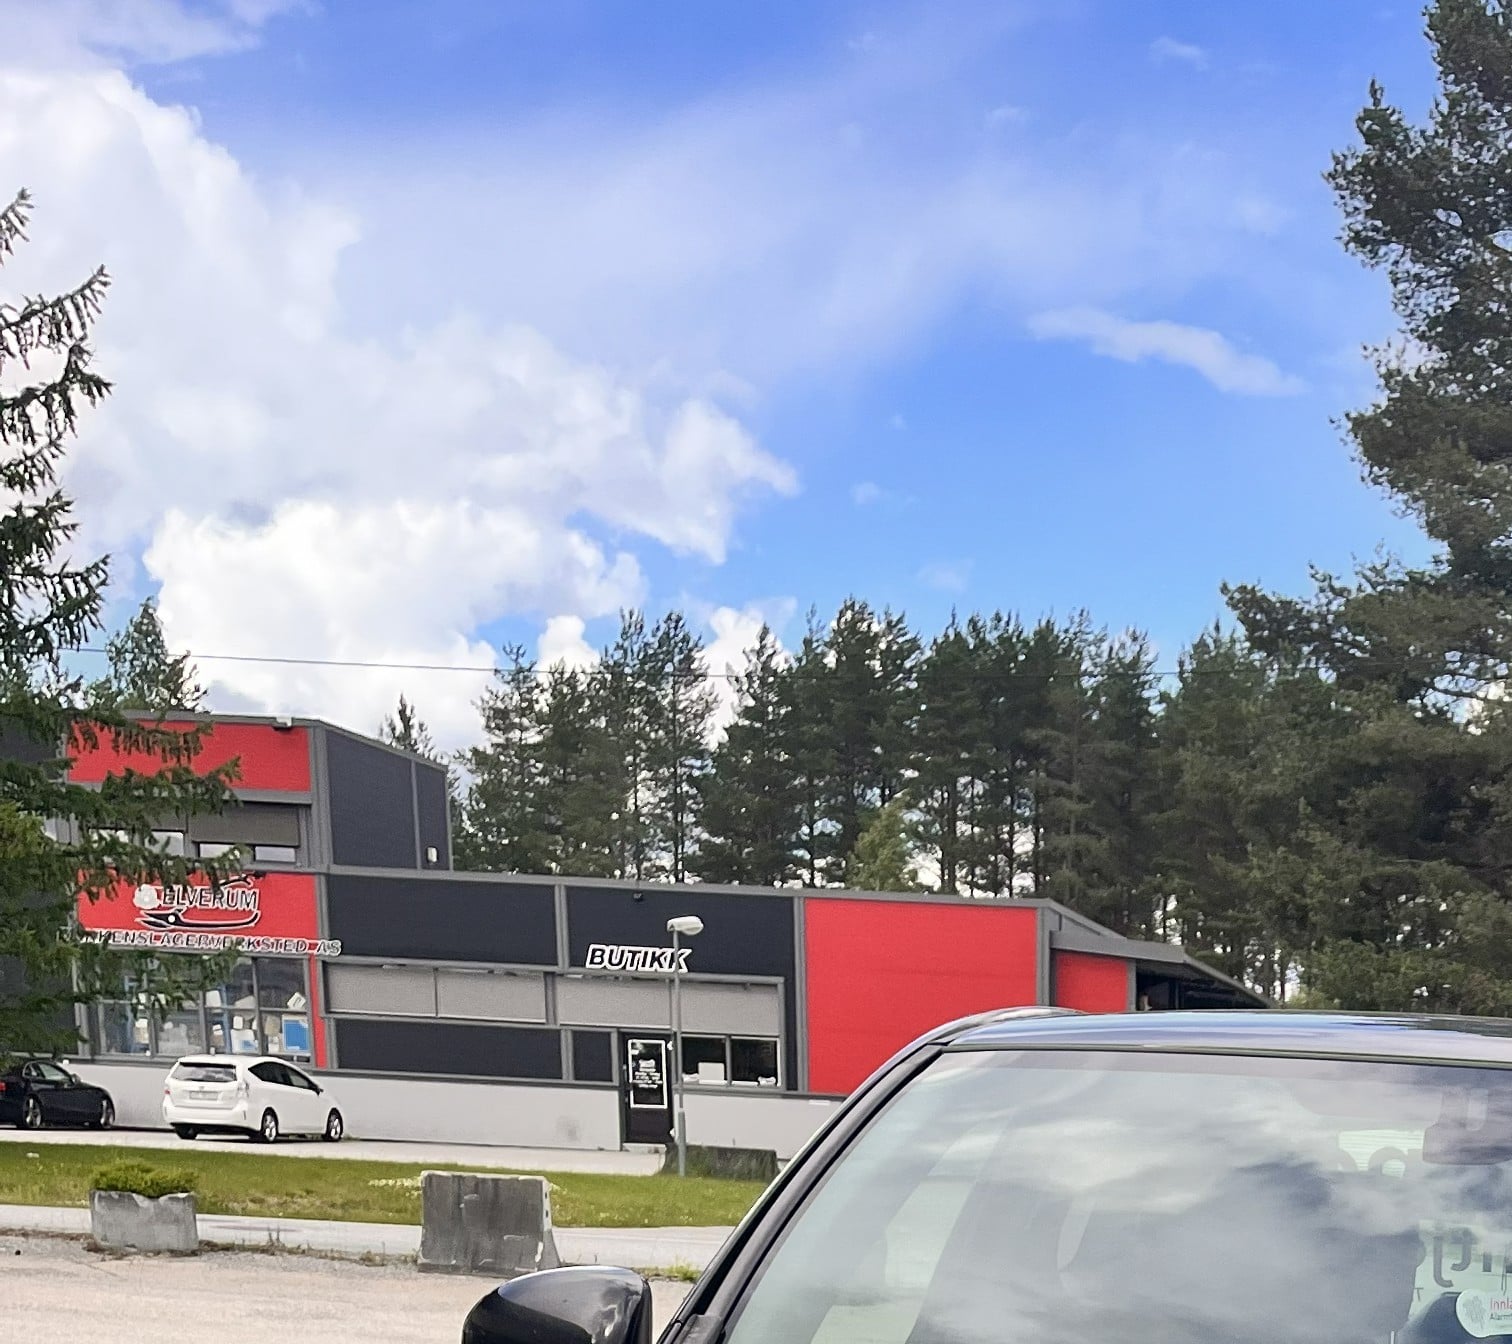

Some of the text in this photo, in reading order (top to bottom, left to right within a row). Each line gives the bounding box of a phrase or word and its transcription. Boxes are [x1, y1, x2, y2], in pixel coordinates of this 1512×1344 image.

[160, 884, 259, 910] ELVERUM
[56, 925, 343, 957] KENSLAGERVERKSTED AS
[585, 943, 693, 973] BUTIKK
